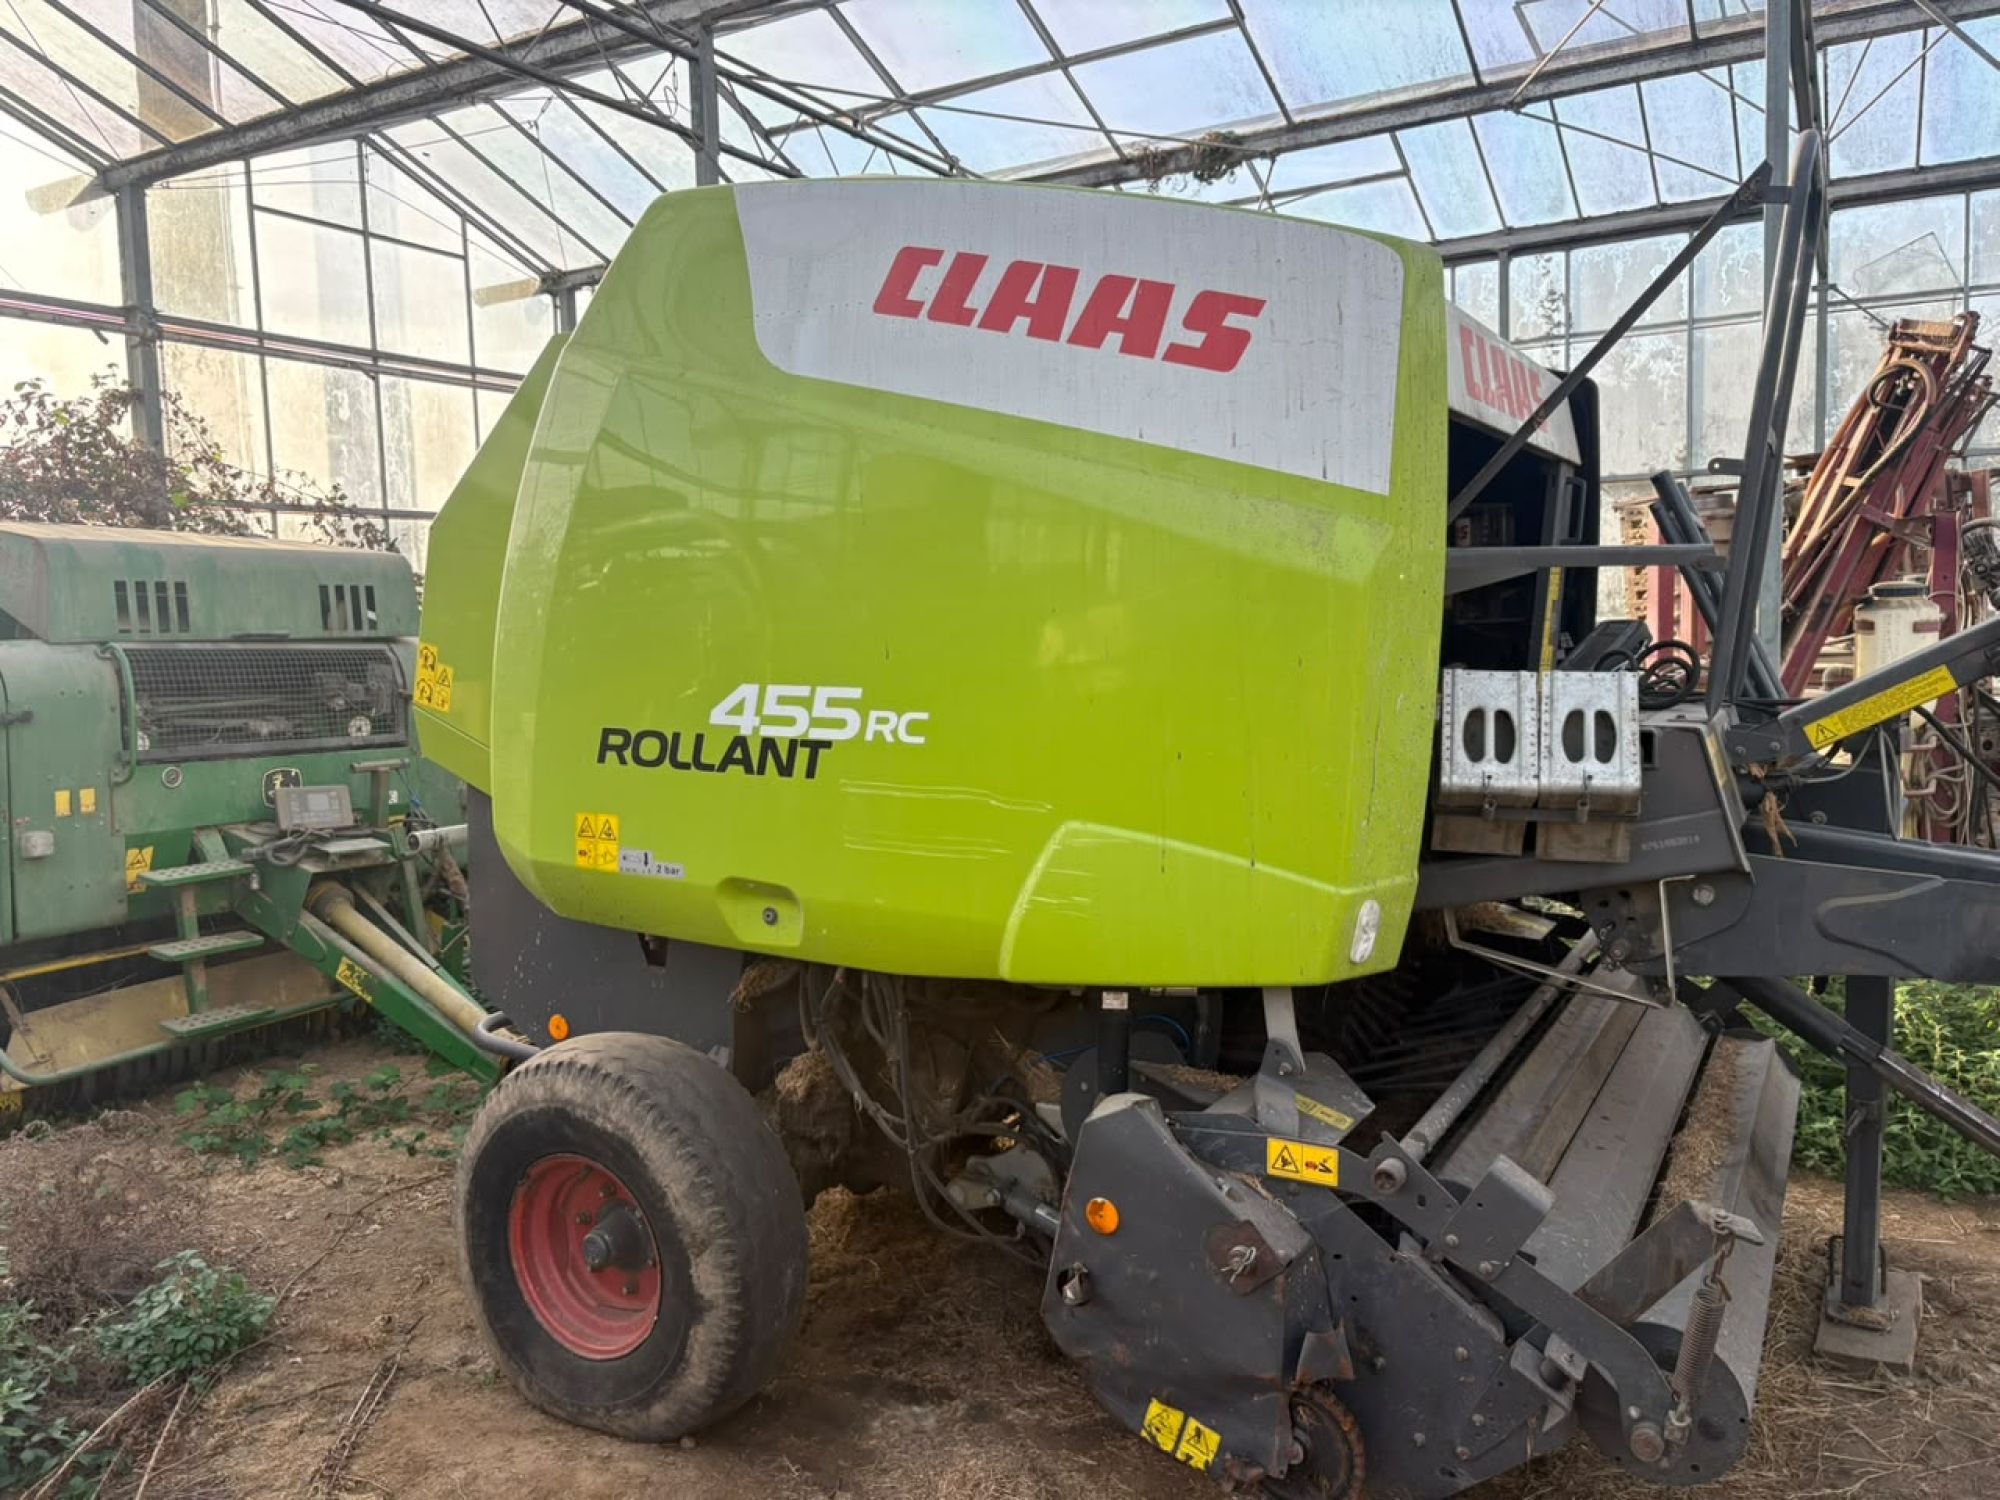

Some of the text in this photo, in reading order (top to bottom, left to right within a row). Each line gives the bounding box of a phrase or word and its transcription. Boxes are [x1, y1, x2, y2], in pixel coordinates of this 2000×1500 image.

[872, 246, 1267, 373] CLAAS
[709, 683, 929, 744] 455 RC
[596, 727, 833, 780] ROLLANT
